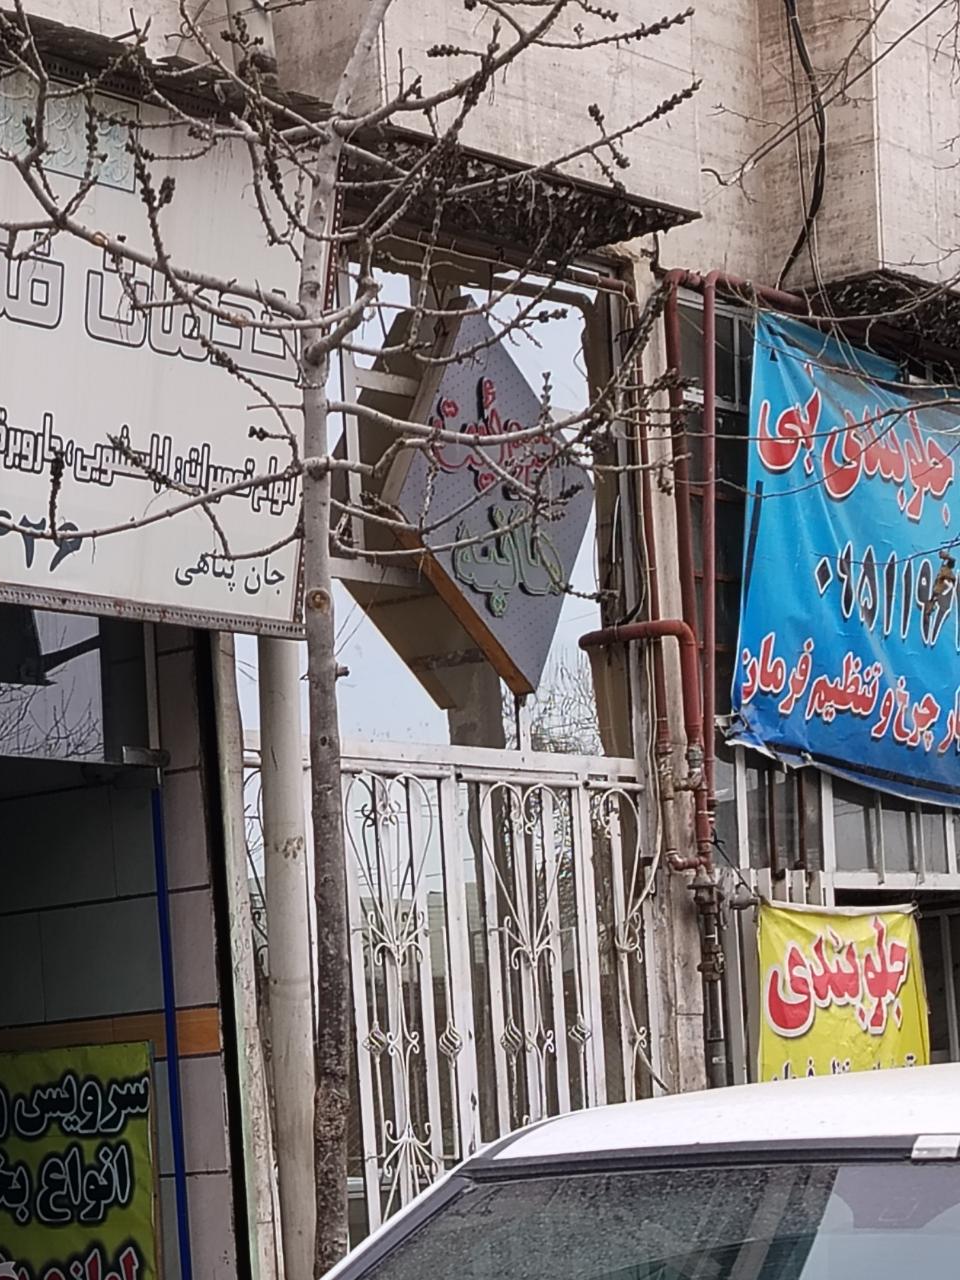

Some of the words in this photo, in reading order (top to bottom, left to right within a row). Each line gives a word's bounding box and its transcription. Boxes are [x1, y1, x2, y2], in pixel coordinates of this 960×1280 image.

[244, 558, 286, 595] جان
[804, 652, 884, 722] تنظیم
[871, 688, 895, 739] و
[893, 676, 941, 752] چرخ
[15, 1075, 149, 1135] سرویس
[37, 1145, 130, 1221] انواع
